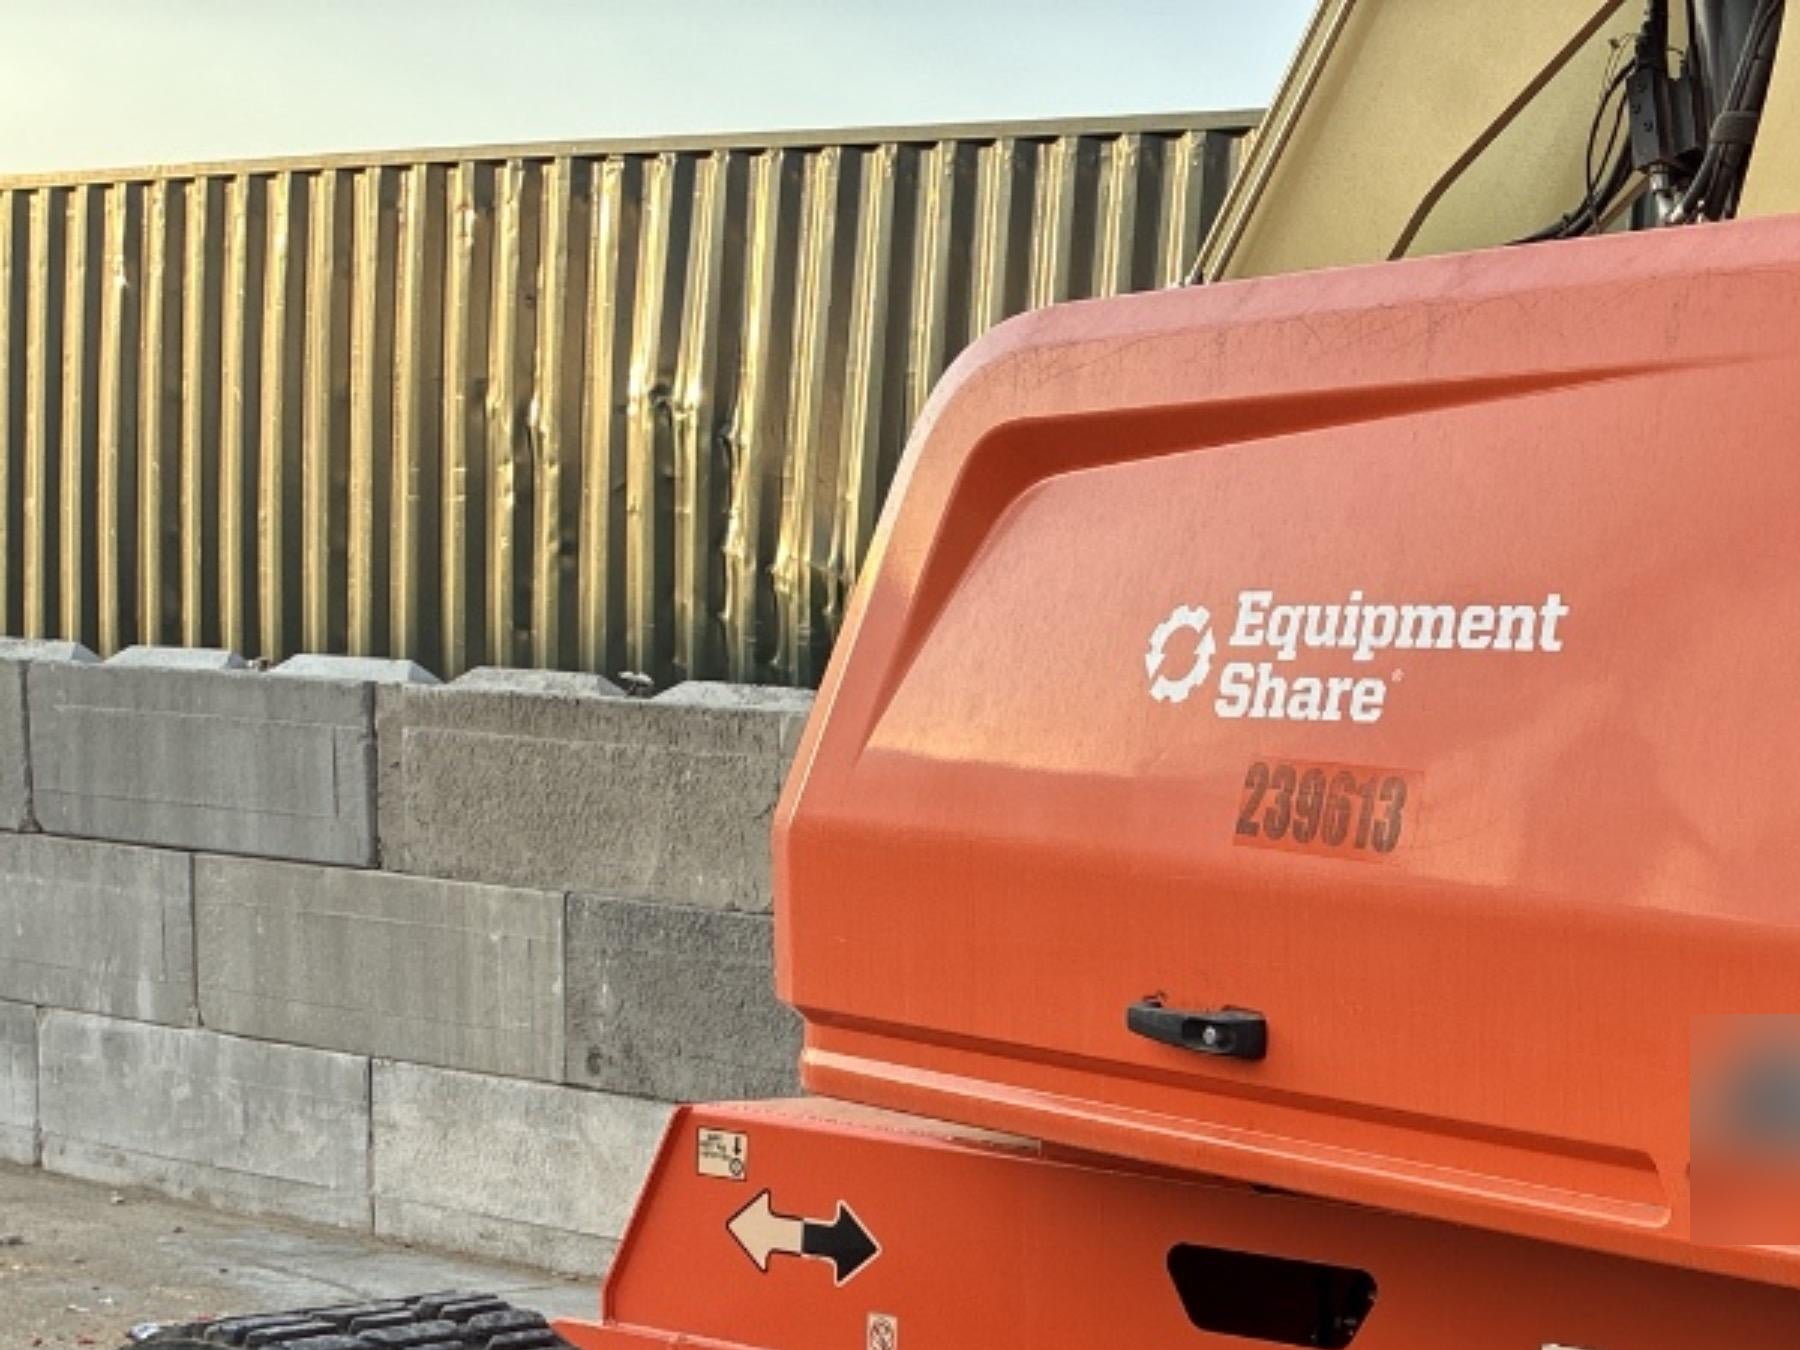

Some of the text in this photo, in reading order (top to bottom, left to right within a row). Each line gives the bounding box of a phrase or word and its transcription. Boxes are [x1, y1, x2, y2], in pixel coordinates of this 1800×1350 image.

[1229, 590, 1569, 661] Equipment
[1214, 662, 1387, 723] Share
[1234, 761, 1408, 854] 239613
